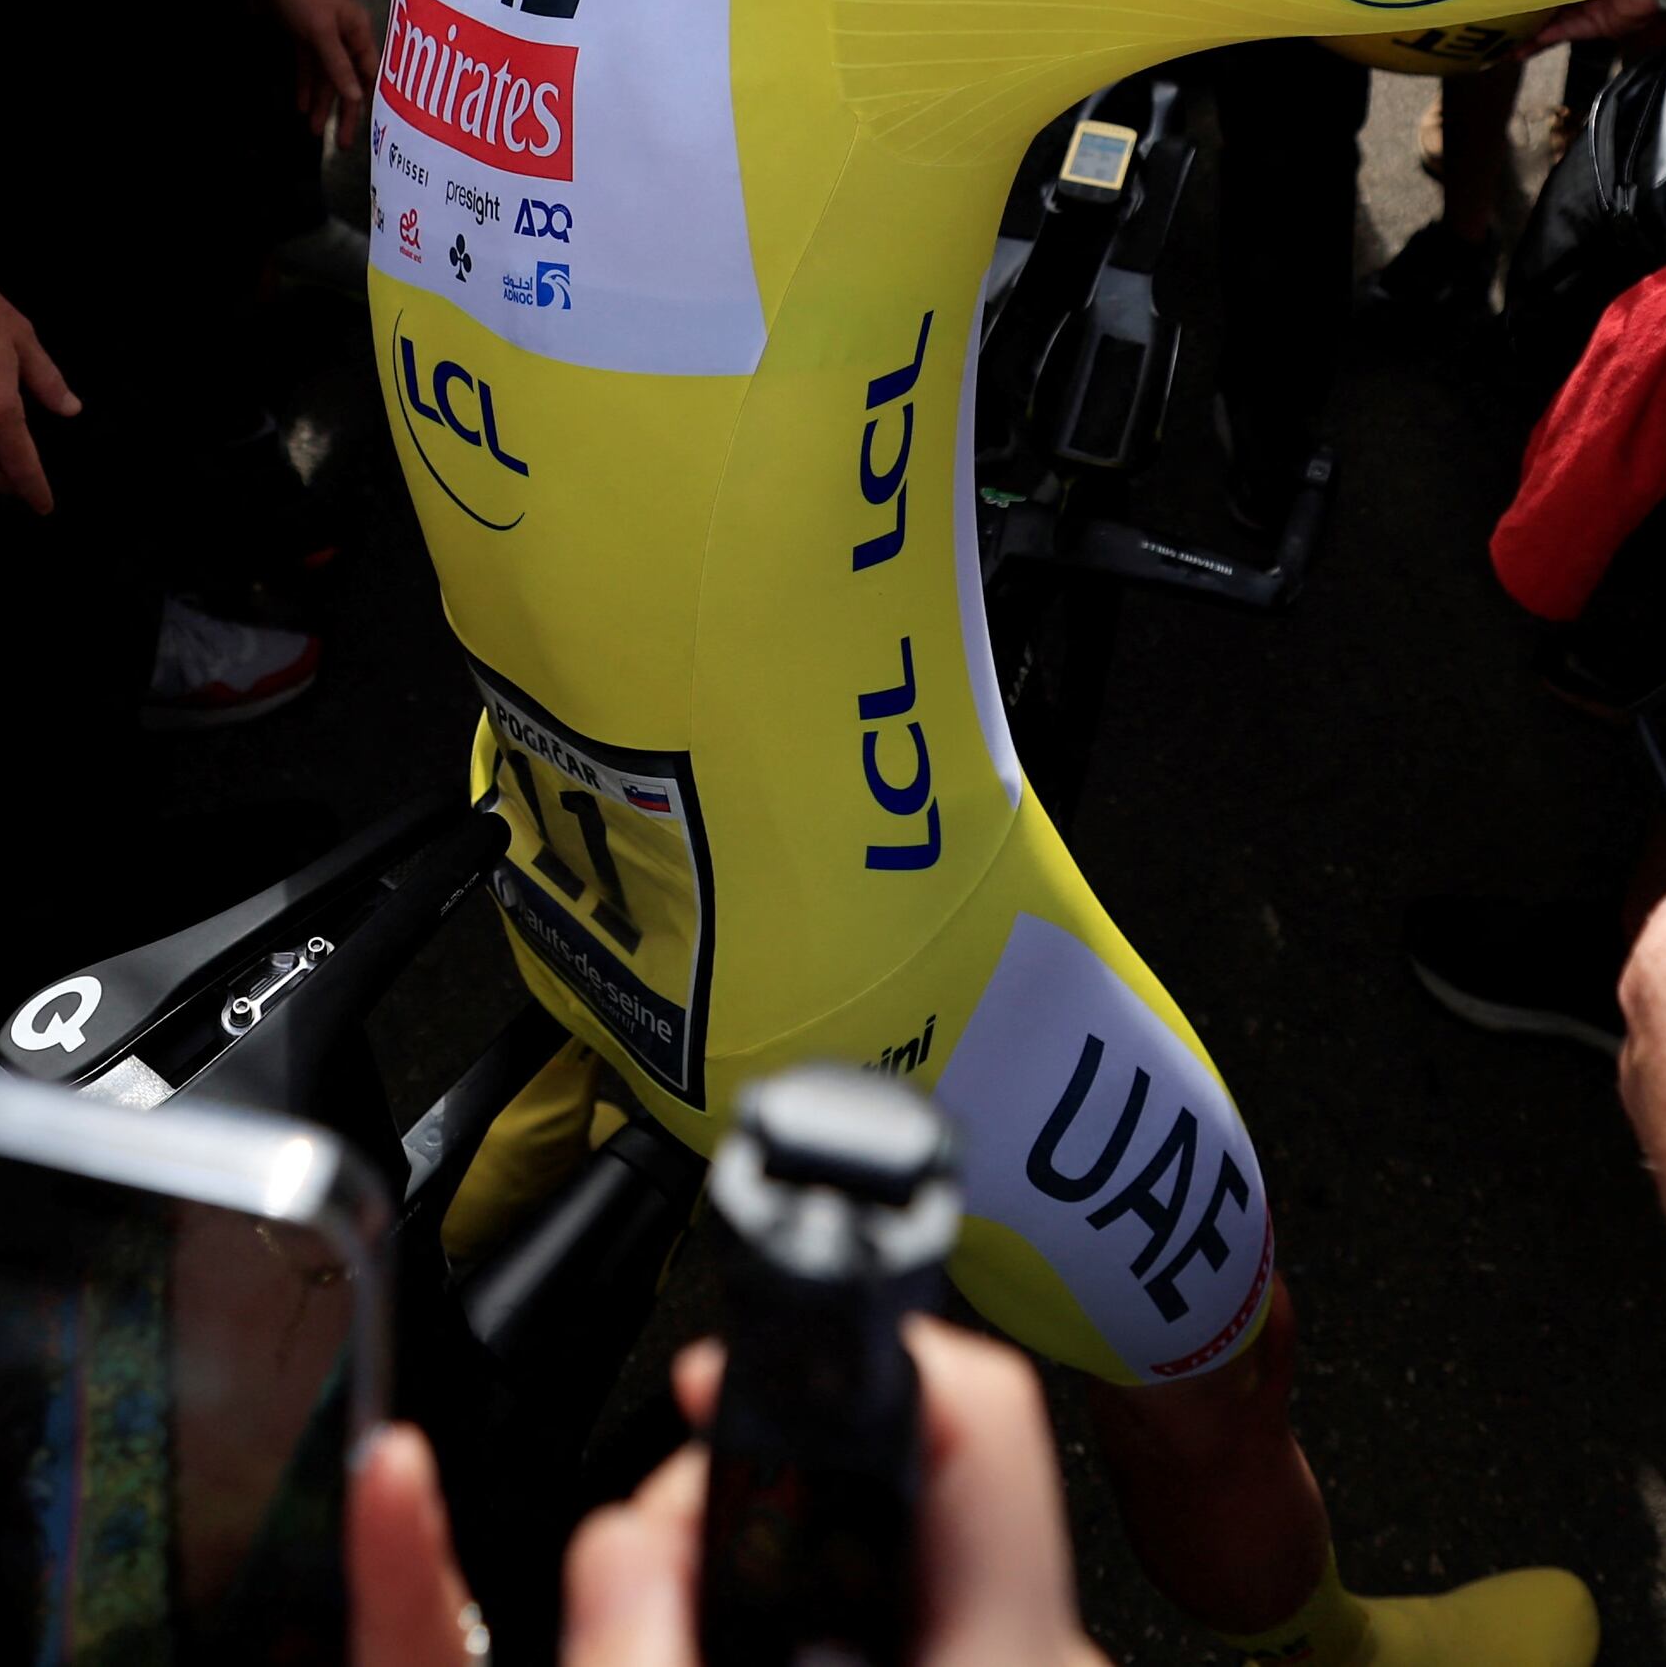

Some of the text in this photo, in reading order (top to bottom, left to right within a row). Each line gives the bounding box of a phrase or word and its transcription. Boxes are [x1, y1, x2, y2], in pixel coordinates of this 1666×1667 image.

[396, 153, 429, 187] PISSEI
[445, 180, 500, 225] presight
[514, 198, 573, 243] ADQ
[503, 287, 533, 306] ADNOC
[400, 335, 530, 478] LCL
[852, 309, 934, 572] LCL
[496, 701, 601, 790] POGAČAR
[858, 635, 941, 871] LCL
[503, 749, 644, 957] 11
[1027, 1034, 1248, 1324] UAE
